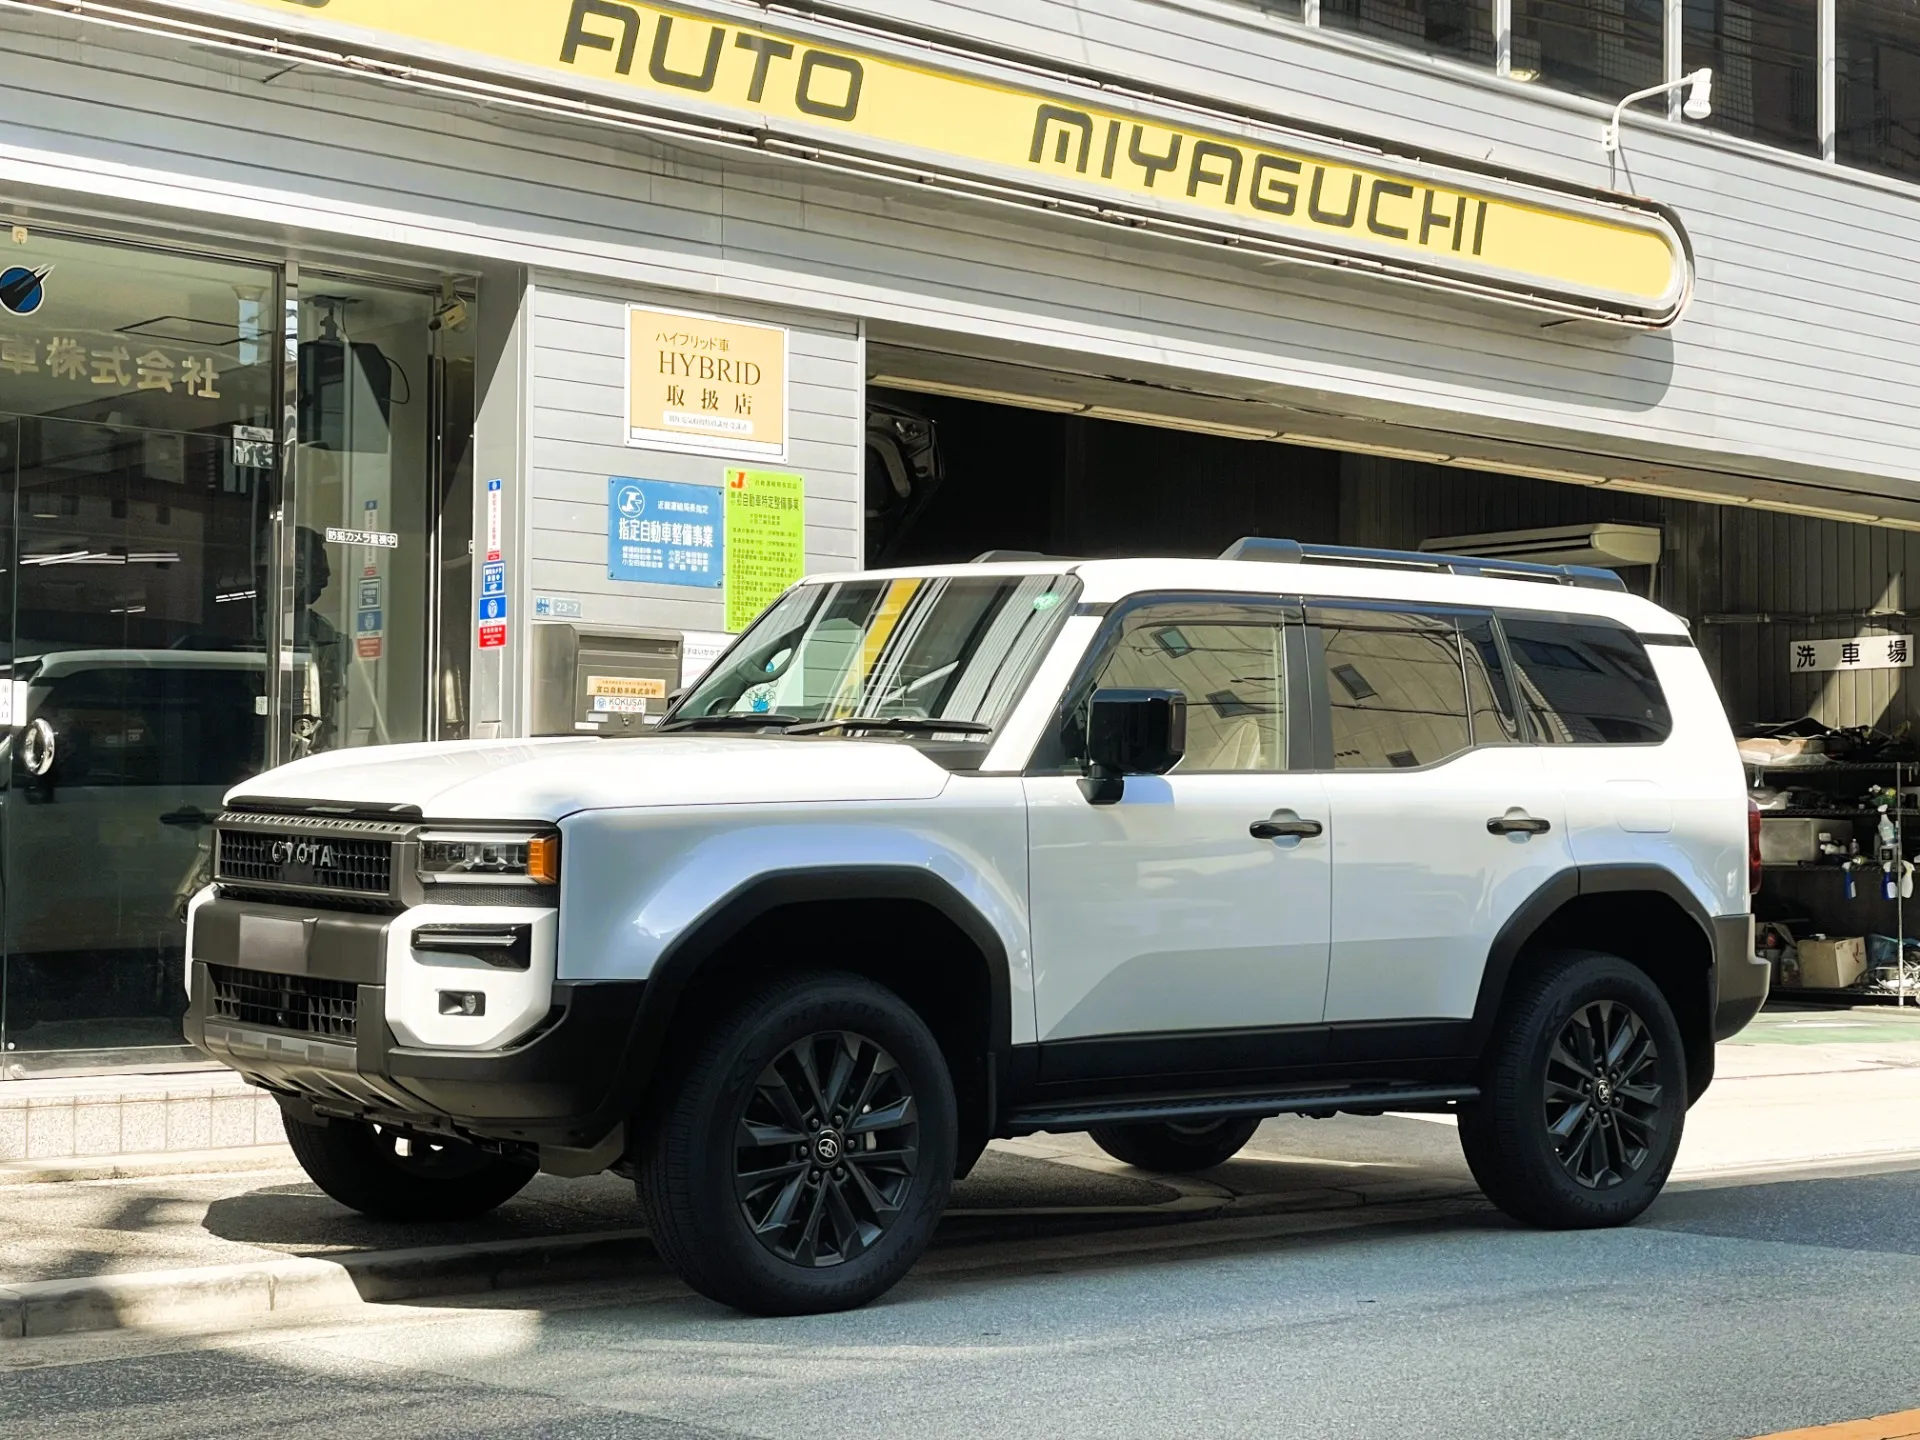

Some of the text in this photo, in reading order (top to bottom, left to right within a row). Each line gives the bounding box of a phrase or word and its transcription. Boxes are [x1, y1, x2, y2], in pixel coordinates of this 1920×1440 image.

[559, 0, 1489, 256] AUTO MIYAGUCHI
[655, 332, 730, 352] ハイブリッド車
[659, 350, 761, 385] HYBRID
[666, 384, 752, 415] 取扱店
[328, 530, 396, 546] 防犯カメラ監視中
[618, 517, 713, 548] 指定自動車整備事業
[556, 602, 579, 613] 23-7
[1796, 640, 1908, 668] 洗車場
[608, 697, 645, 707] KOKUSAI
[262, 840, 335, 867] TOYOTA
